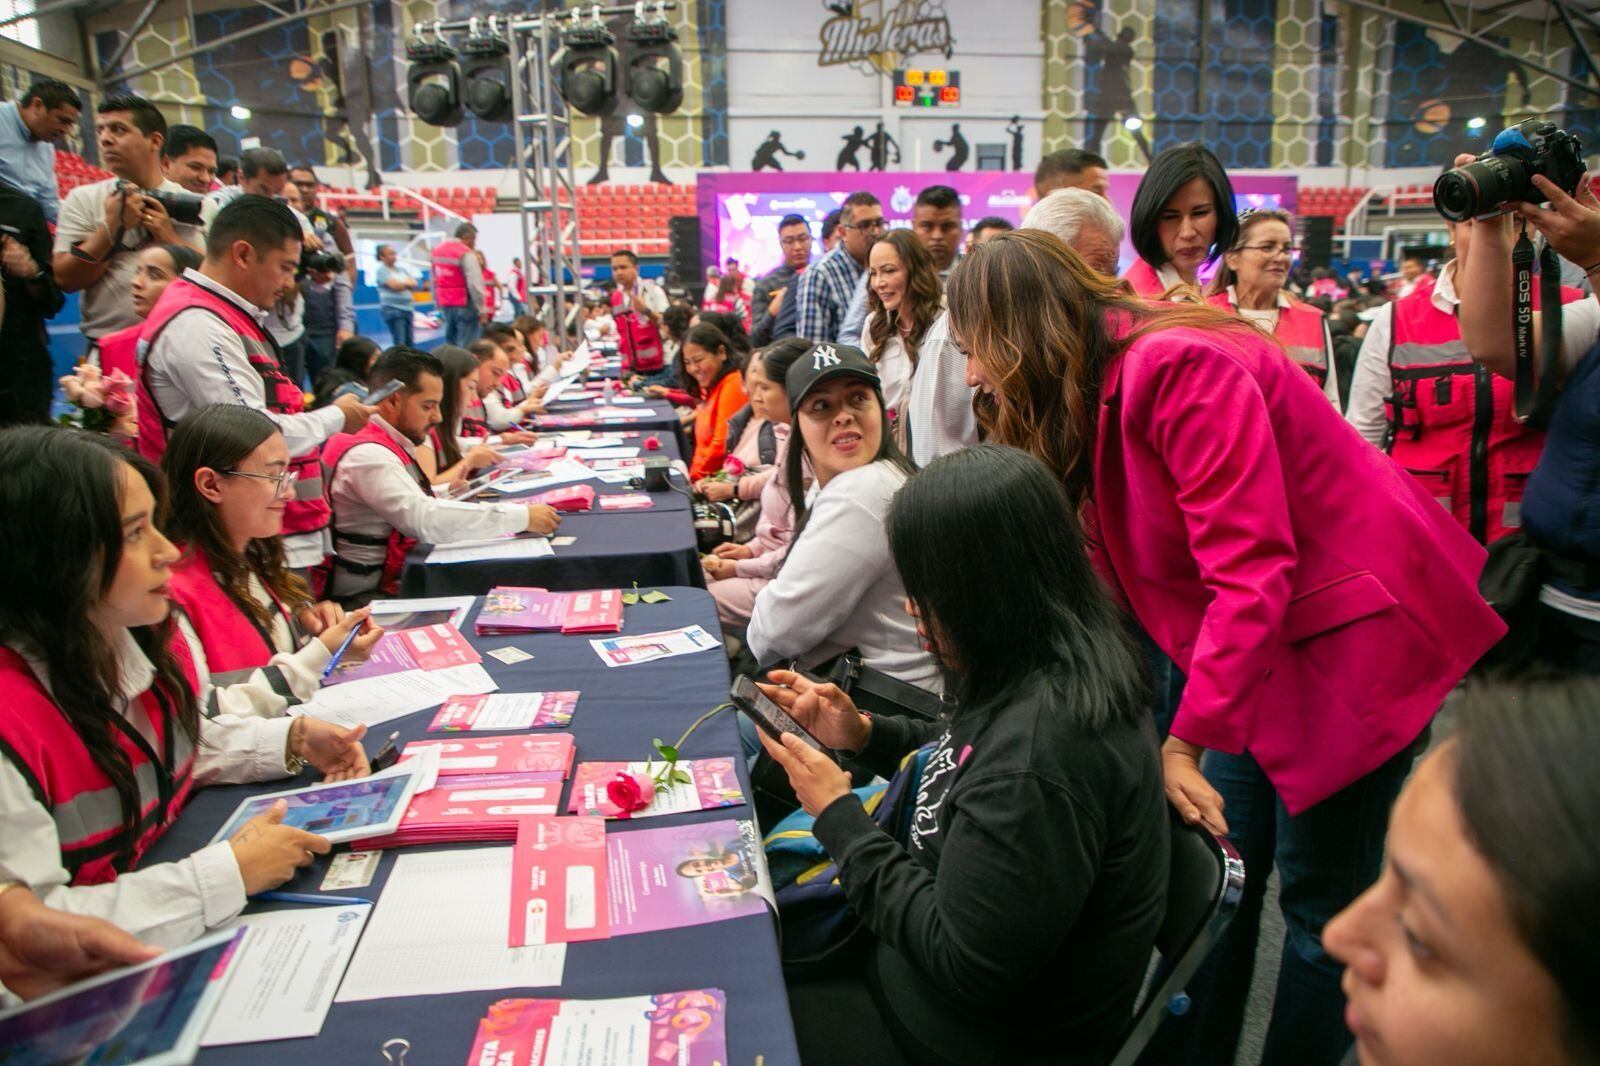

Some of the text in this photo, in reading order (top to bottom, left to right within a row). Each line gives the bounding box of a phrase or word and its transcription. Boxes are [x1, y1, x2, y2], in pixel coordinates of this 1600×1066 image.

[1518, 270, 1530, 358] EOS 5D Mark IV
[812, 344, 842, 370] NY
